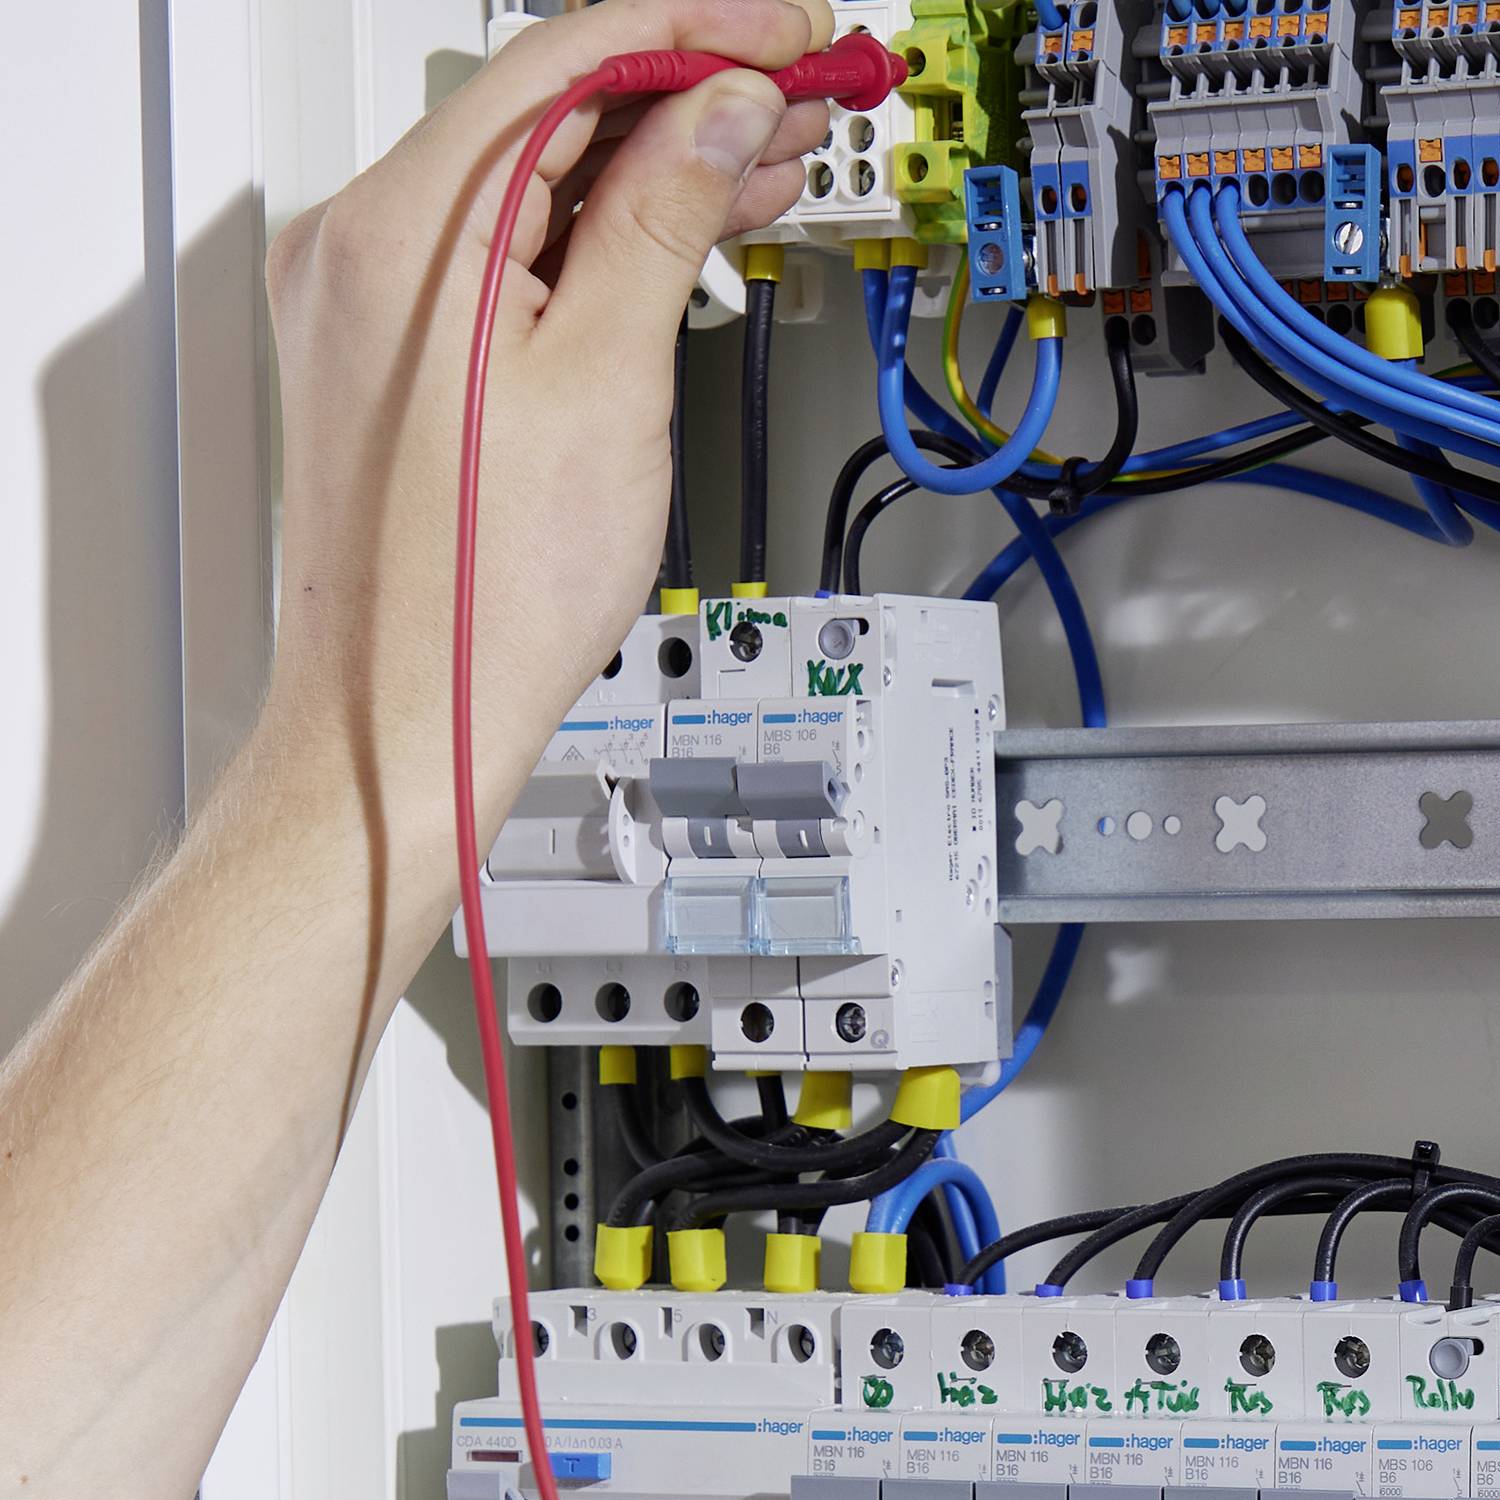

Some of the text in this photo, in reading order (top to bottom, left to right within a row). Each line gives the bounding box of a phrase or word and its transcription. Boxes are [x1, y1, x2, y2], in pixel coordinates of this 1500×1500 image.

[672, 734, 722, 746] MBN 116
[764, 728, 817, 741] MBS 106
[763, 742, 781, 755] B6
[996, 1449, 1048, 1463] MBN 116
[996, 1463, 1019, 1476] B16
[1378, 1458, 1433, 1472] MBS 106
[1379, 1472, 1397, 1485] B6
[1477, 1473, 1494, 1486] B6
